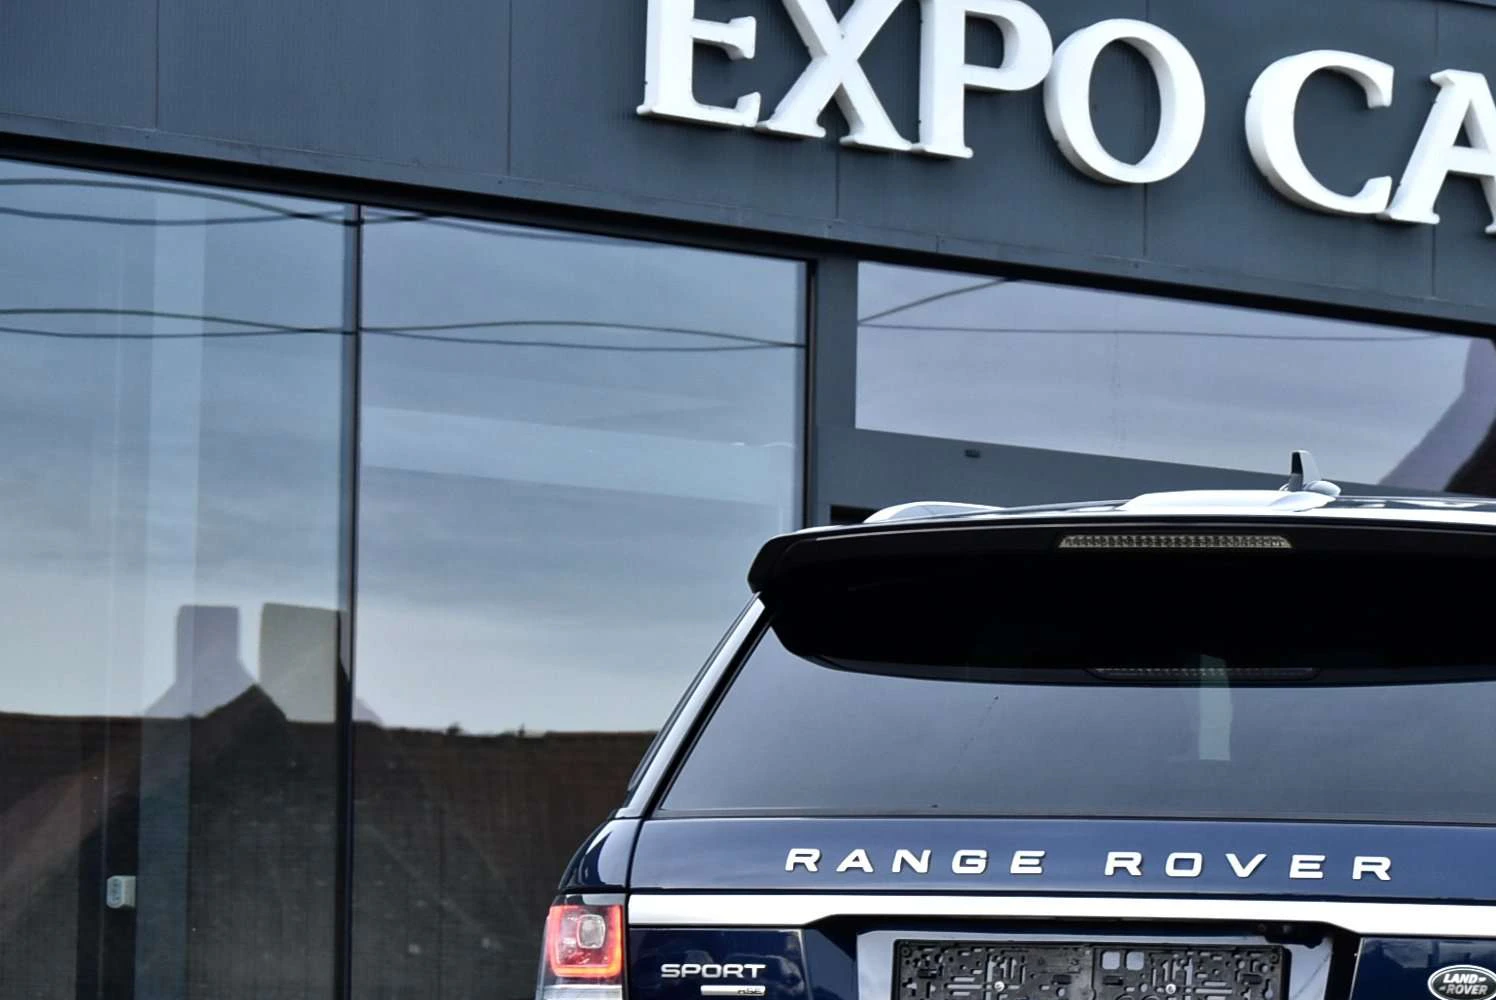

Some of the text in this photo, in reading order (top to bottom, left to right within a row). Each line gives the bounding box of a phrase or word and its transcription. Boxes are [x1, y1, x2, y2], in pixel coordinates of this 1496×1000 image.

[636, 0, 1206, 184] EXPO
[784, 847, 1391, 881] RANGE ROVER
[660, 963, 767, 978] SPORT
